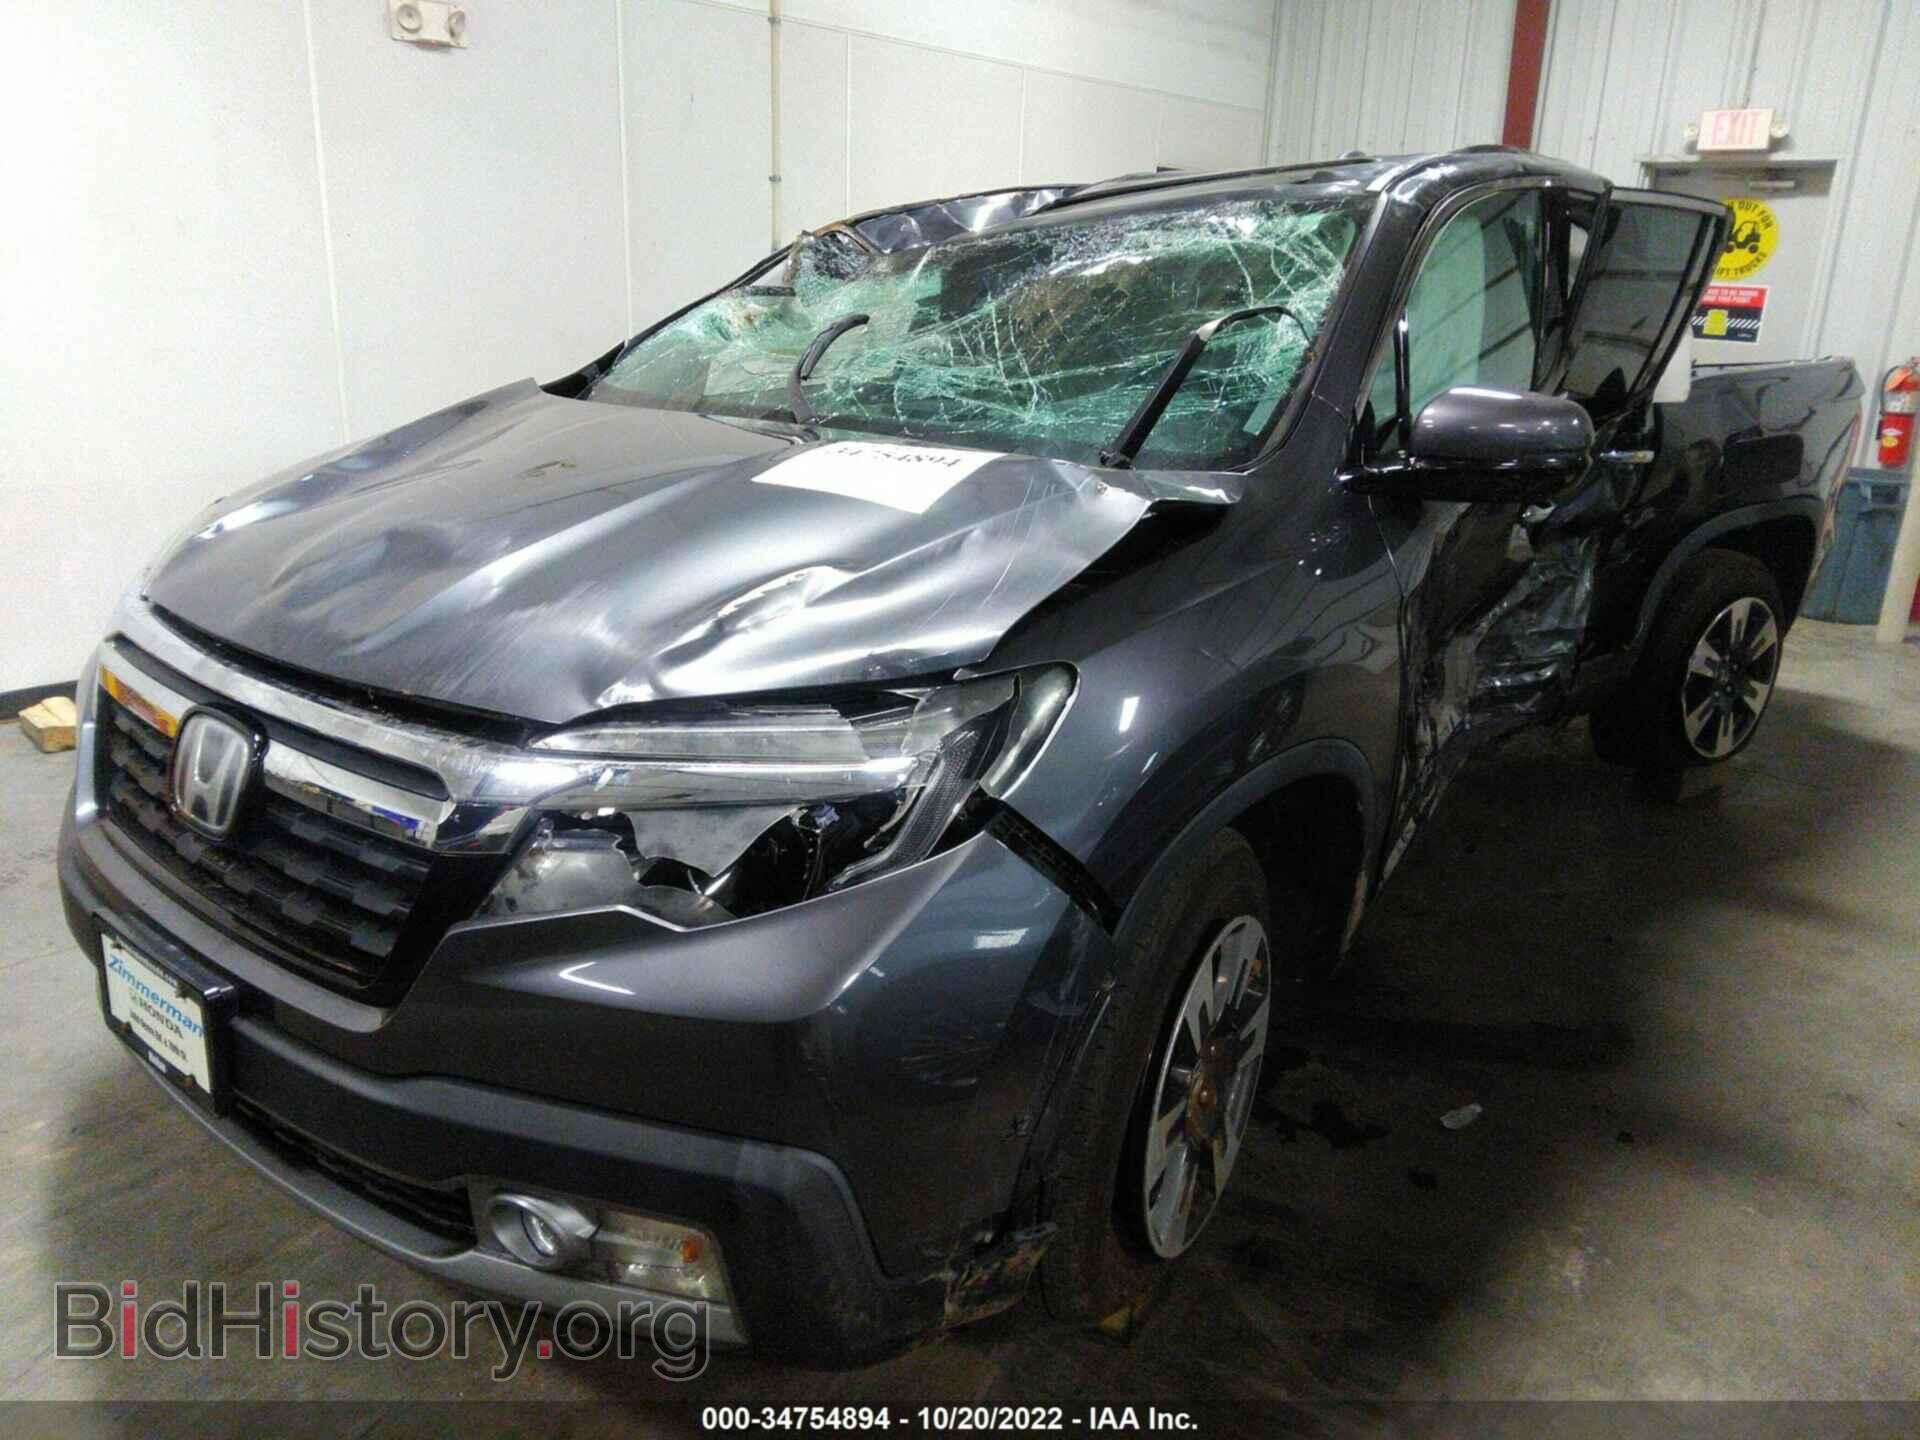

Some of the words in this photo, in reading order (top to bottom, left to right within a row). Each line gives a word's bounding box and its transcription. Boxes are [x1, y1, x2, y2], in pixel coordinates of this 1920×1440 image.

[1711, 111, 1760, 145] EXIT
[1737, 200, 1759, 211] OUT
[1758, 208, 1774, 229] FOR
[1734, 252, 1768, 275] TRUCKS
[107, 954, 204, 1038] Zimmerman
